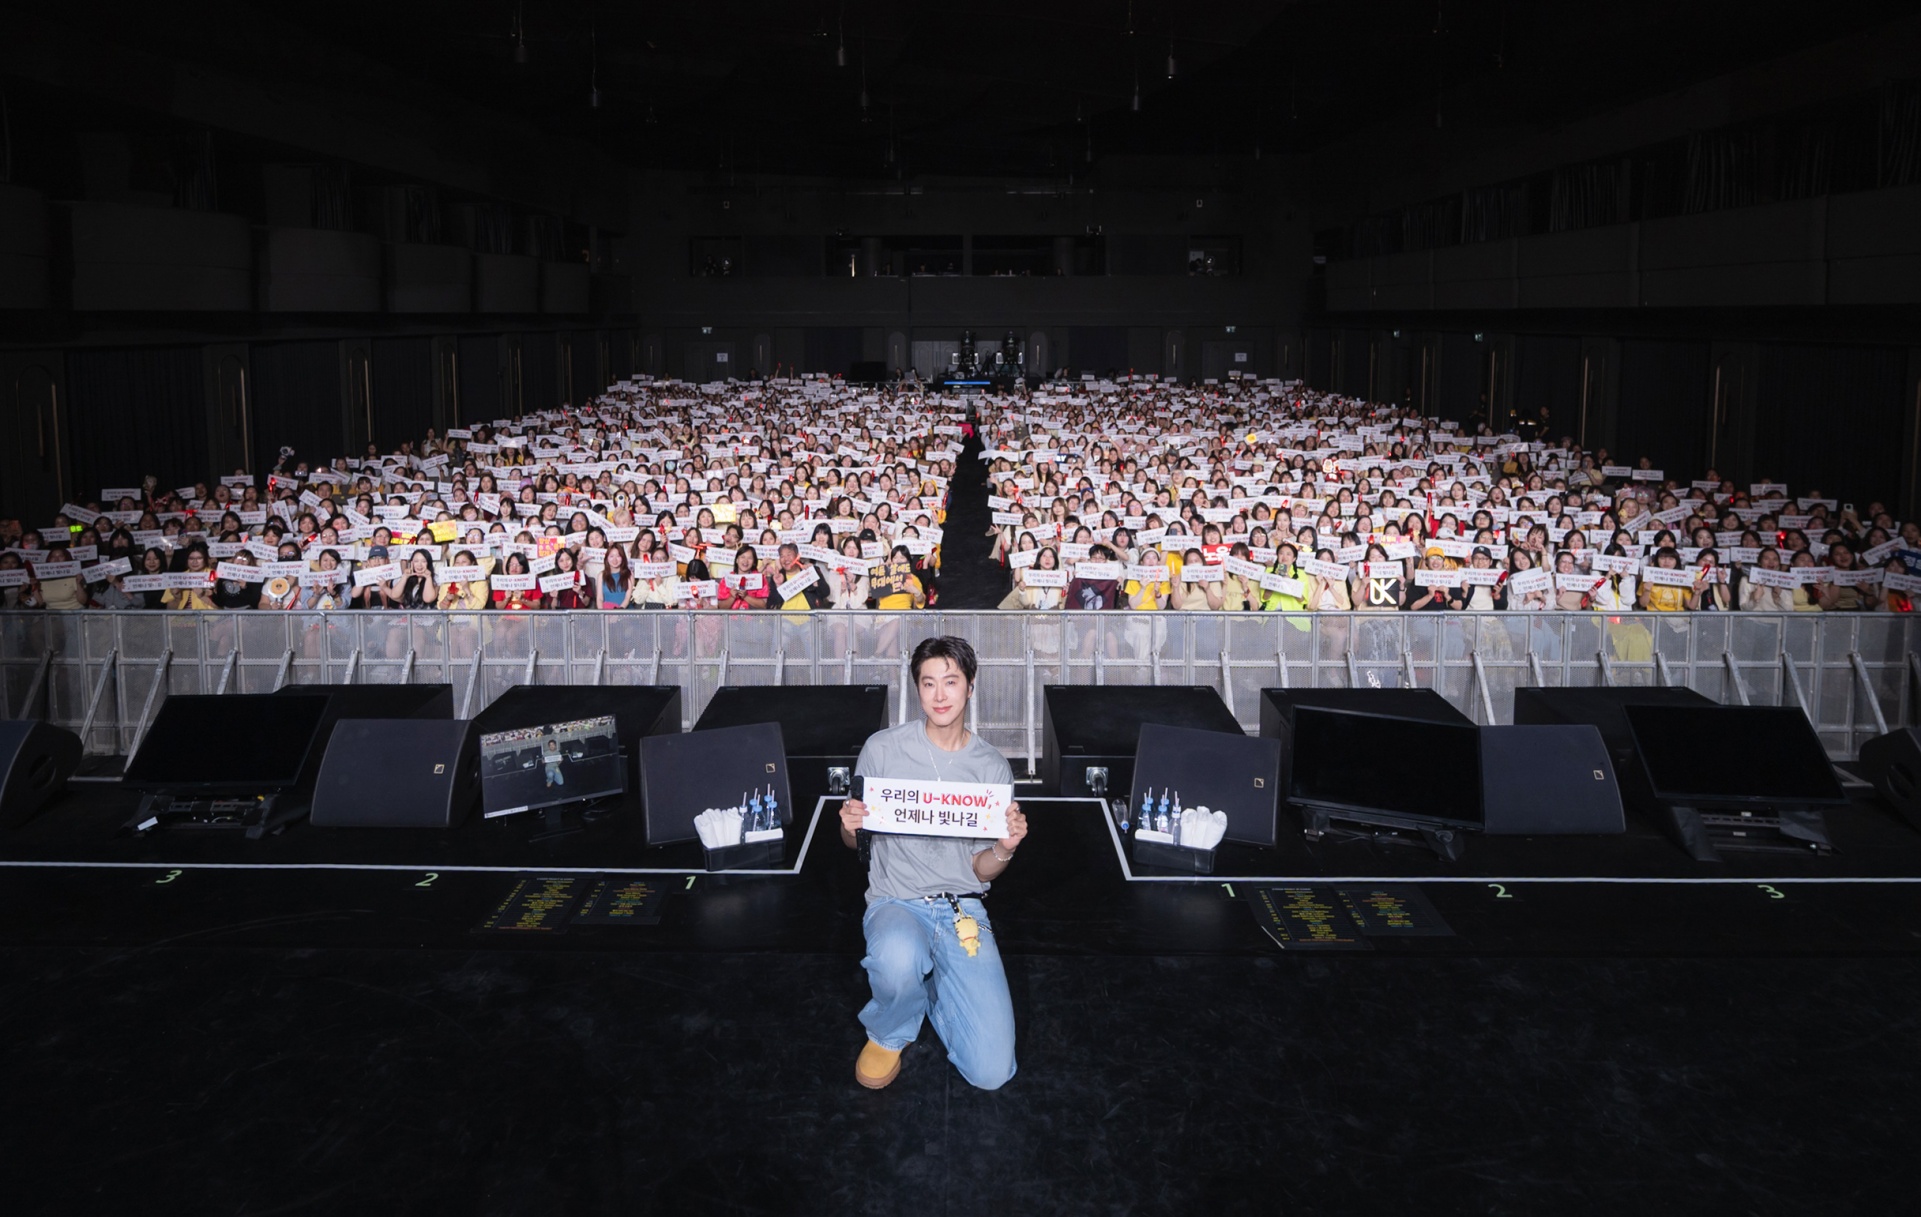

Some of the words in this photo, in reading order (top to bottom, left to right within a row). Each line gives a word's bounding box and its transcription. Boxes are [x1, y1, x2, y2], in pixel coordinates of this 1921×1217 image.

[880, 788, 919, 804] 우리의
[894, 808, 934, 824] 언제나
[938, 811, 978, 828] 빛나길
[156, 869, 182, 884] 3
[415, 873, 439, 887] 2
[685, 875, 697, 890] 1
[1221, 883, 1236, 898] 1
[1488, 884, 1512, 898] 2
[1758, 885, 1785, 899] 3
